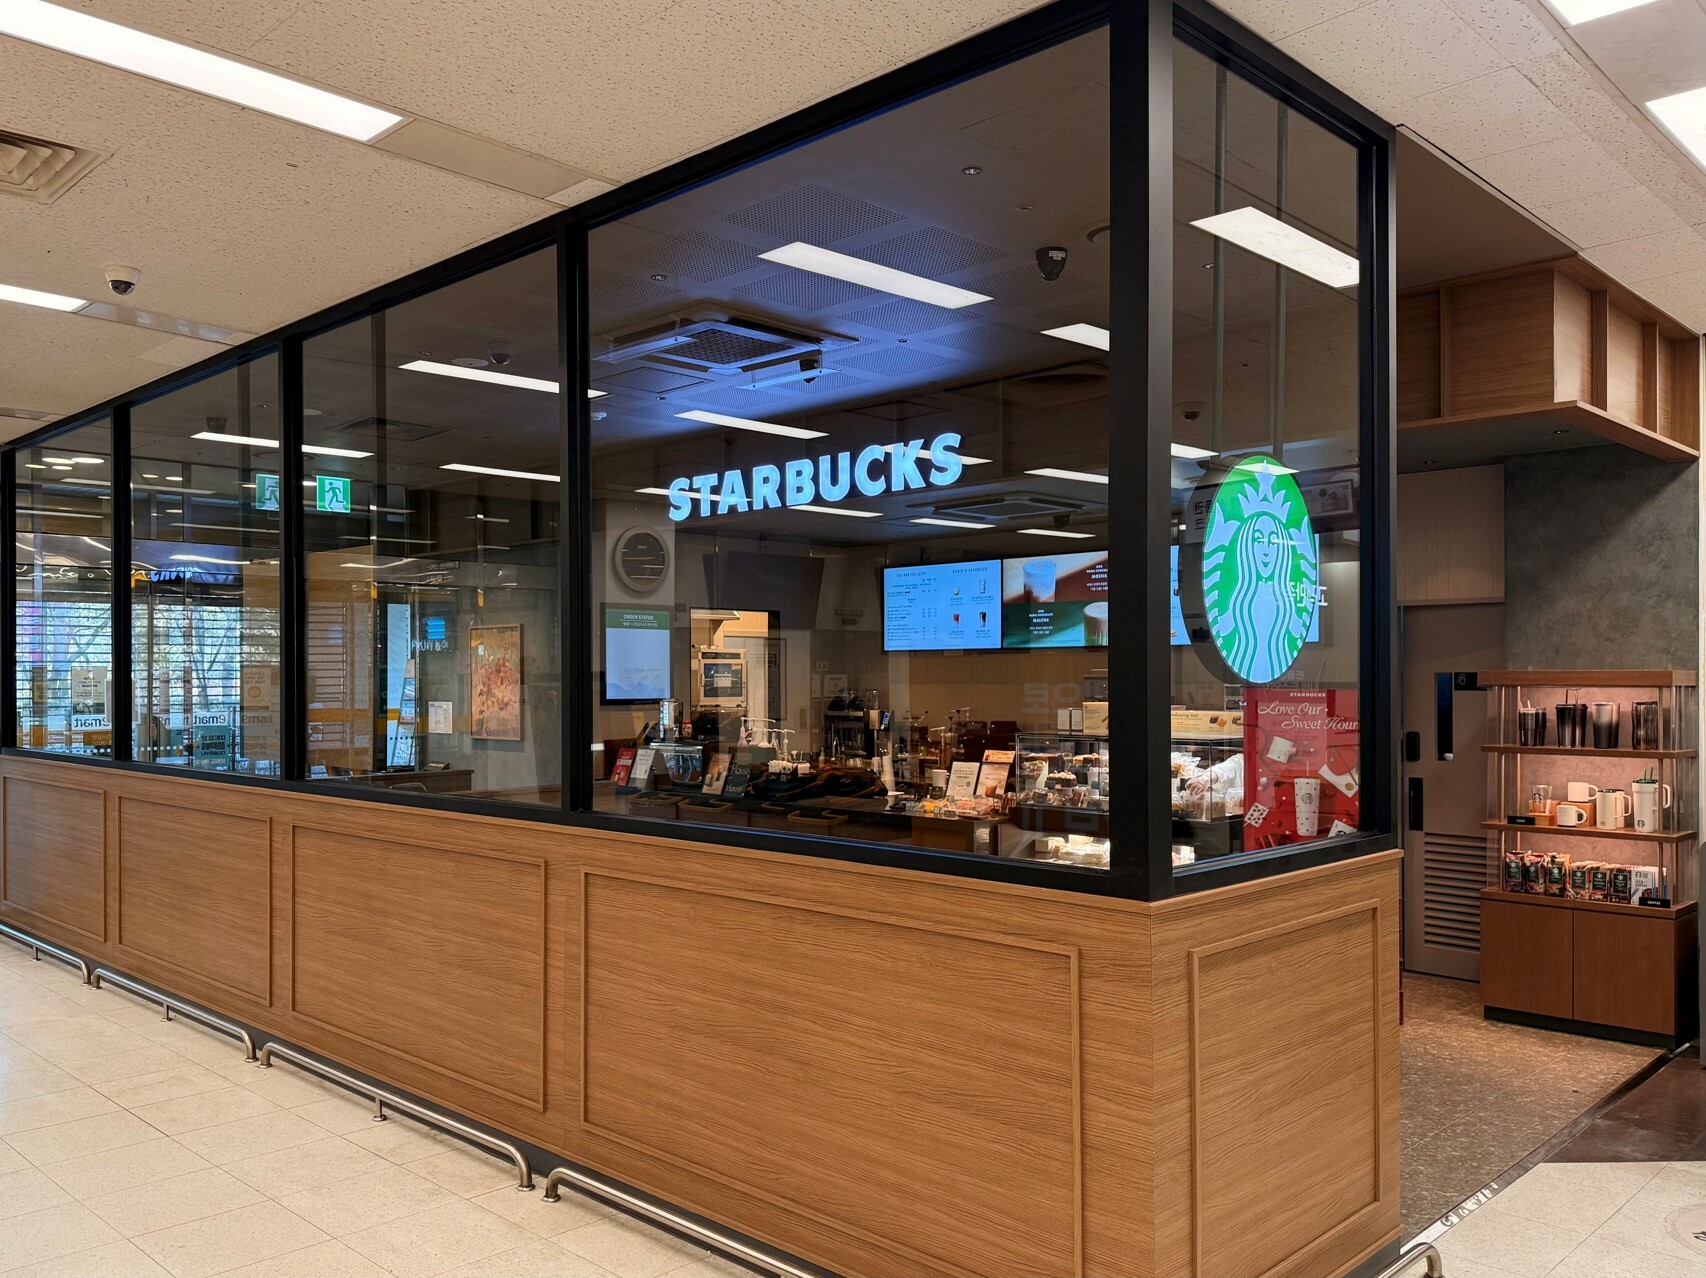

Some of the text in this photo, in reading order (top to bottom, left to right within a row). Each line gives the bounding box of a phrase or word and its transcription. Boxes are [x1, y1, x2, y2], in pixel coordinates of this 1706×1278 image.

[667, 432, 964, 523] STARBUCKS
[1257, 700, 1323, 715] Love Our
[1281, 714, 1321, 729] Sweet
